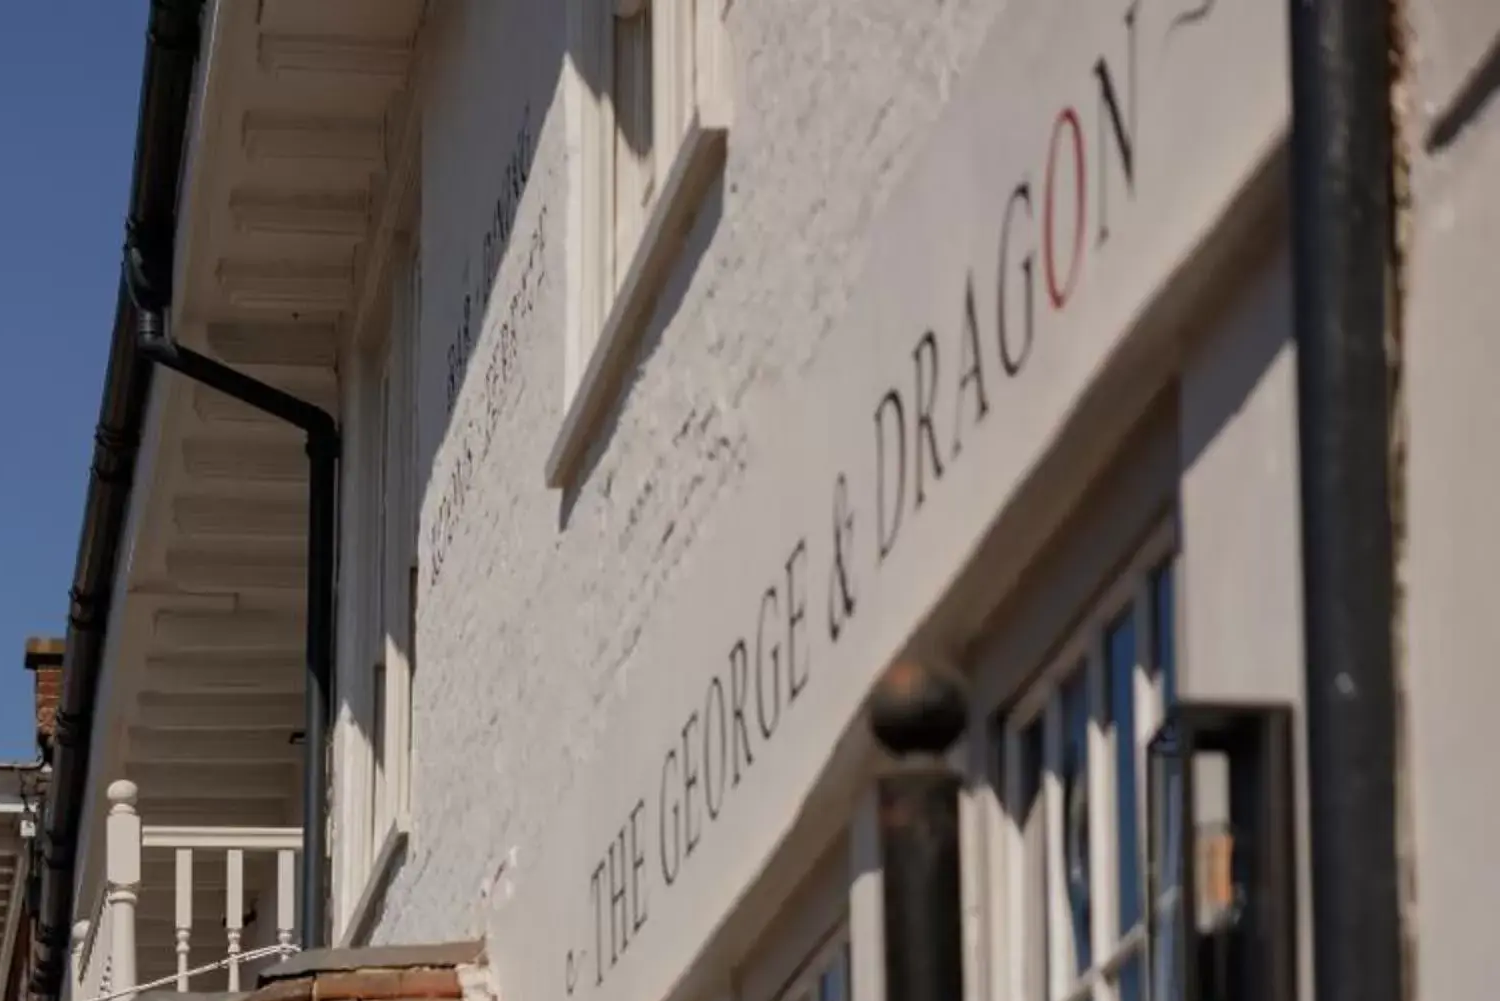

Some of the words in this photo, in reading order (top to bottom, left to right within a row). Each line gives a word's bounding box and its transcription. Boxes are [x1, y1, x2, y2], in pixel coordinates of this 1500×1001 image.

[590, 798, 647, 987] THE
[658, 533, 809, 888] GEORGE
[827, 471, 856, 644] &
[874, 0, 1140, 567] DRAGON
